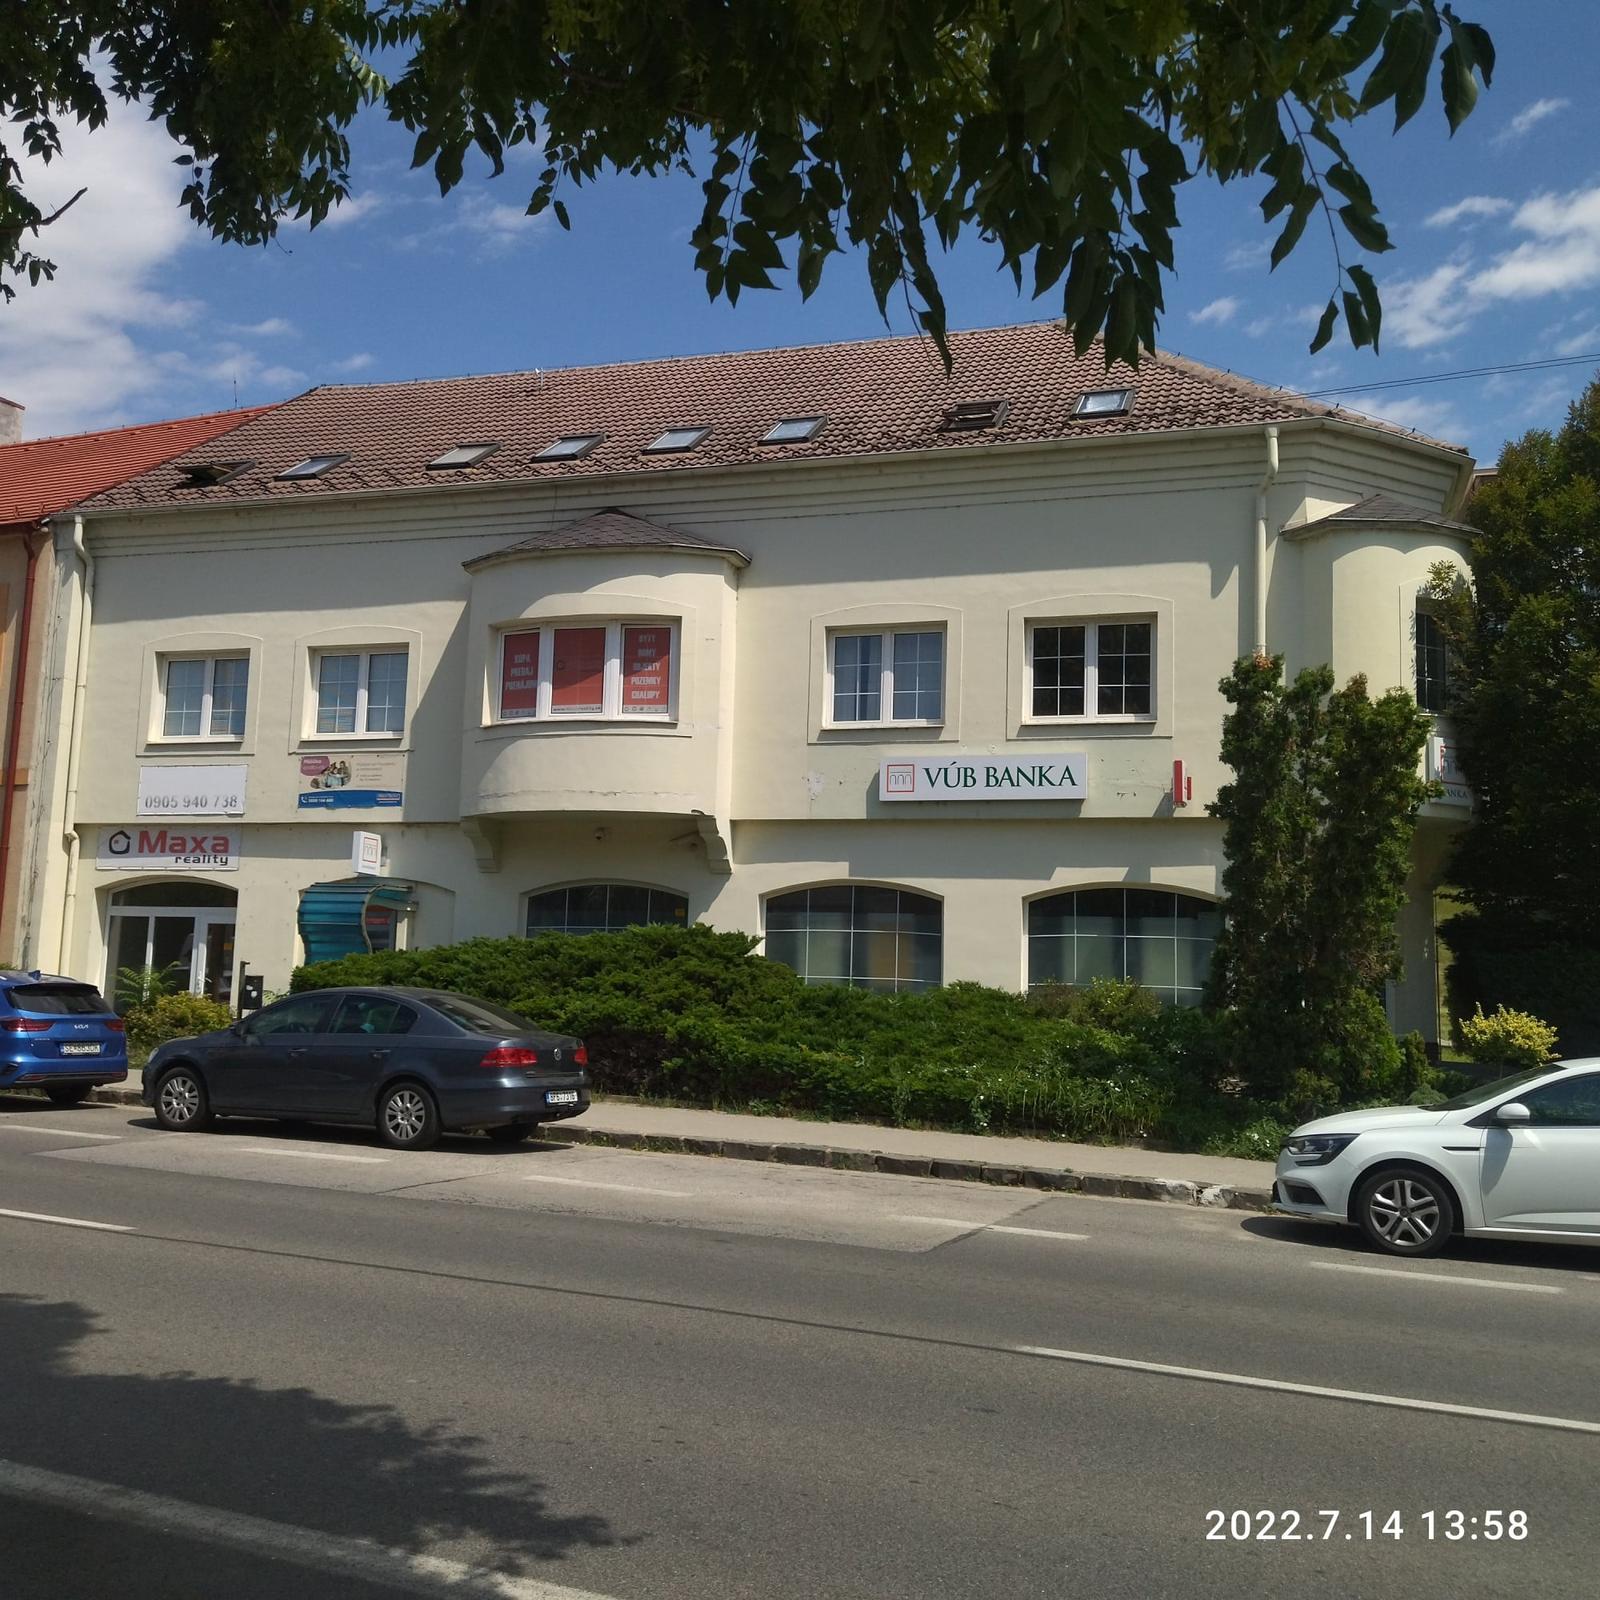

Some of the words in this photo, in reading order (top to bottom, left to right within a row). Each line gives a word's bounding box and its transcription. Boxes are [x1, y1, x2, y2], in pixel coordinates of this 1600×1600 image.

[923, 762, 976, 788] VÚB
[985, 764, 1078, 788] BANKA
[145, 795, 178, 809] 0905
[183, 794, 208, 808] 940
[138, 830, 230, 854] Maxa
[175, 854, 229, 866] reality
